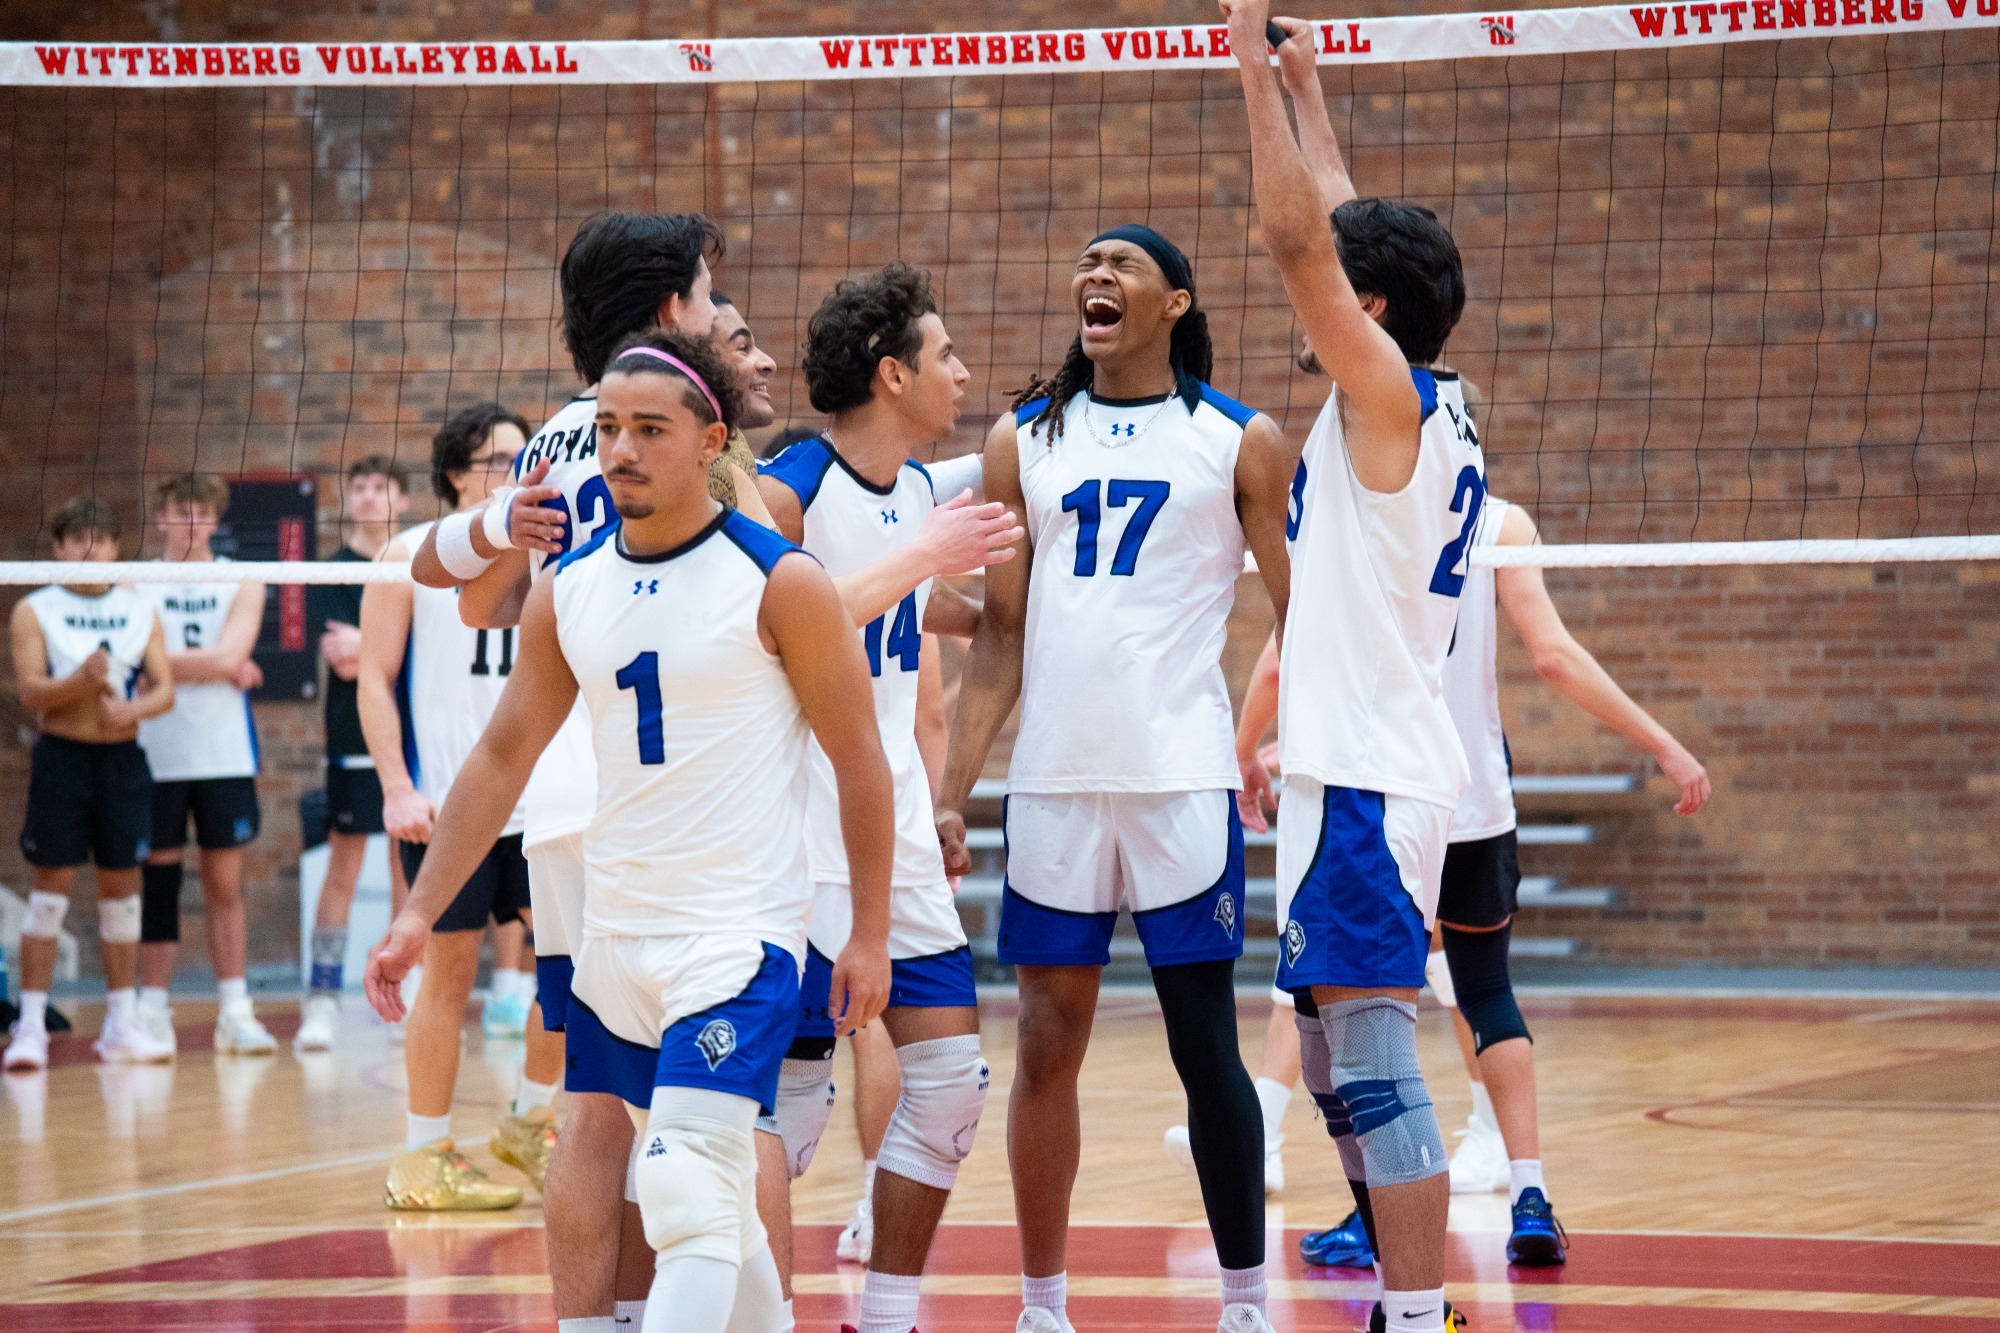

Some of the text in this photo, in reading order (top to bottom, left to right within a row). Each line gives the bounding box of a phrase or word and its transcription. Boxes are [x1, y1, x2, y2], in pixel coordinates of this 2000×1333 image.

[35, 45, 578, 76] WITTENBERG VOLLEYBALL
[820, 23, 1371, 69] WITTENBERG VOLLELL
[1630, 0, 1924, 38] WITTENBERG
[1061, 478, 1171, 577] 17
[1428, 465, 1488, 598] 2
[865, 588, 921, 677] 14
[615, 651, 665, 764] 1
